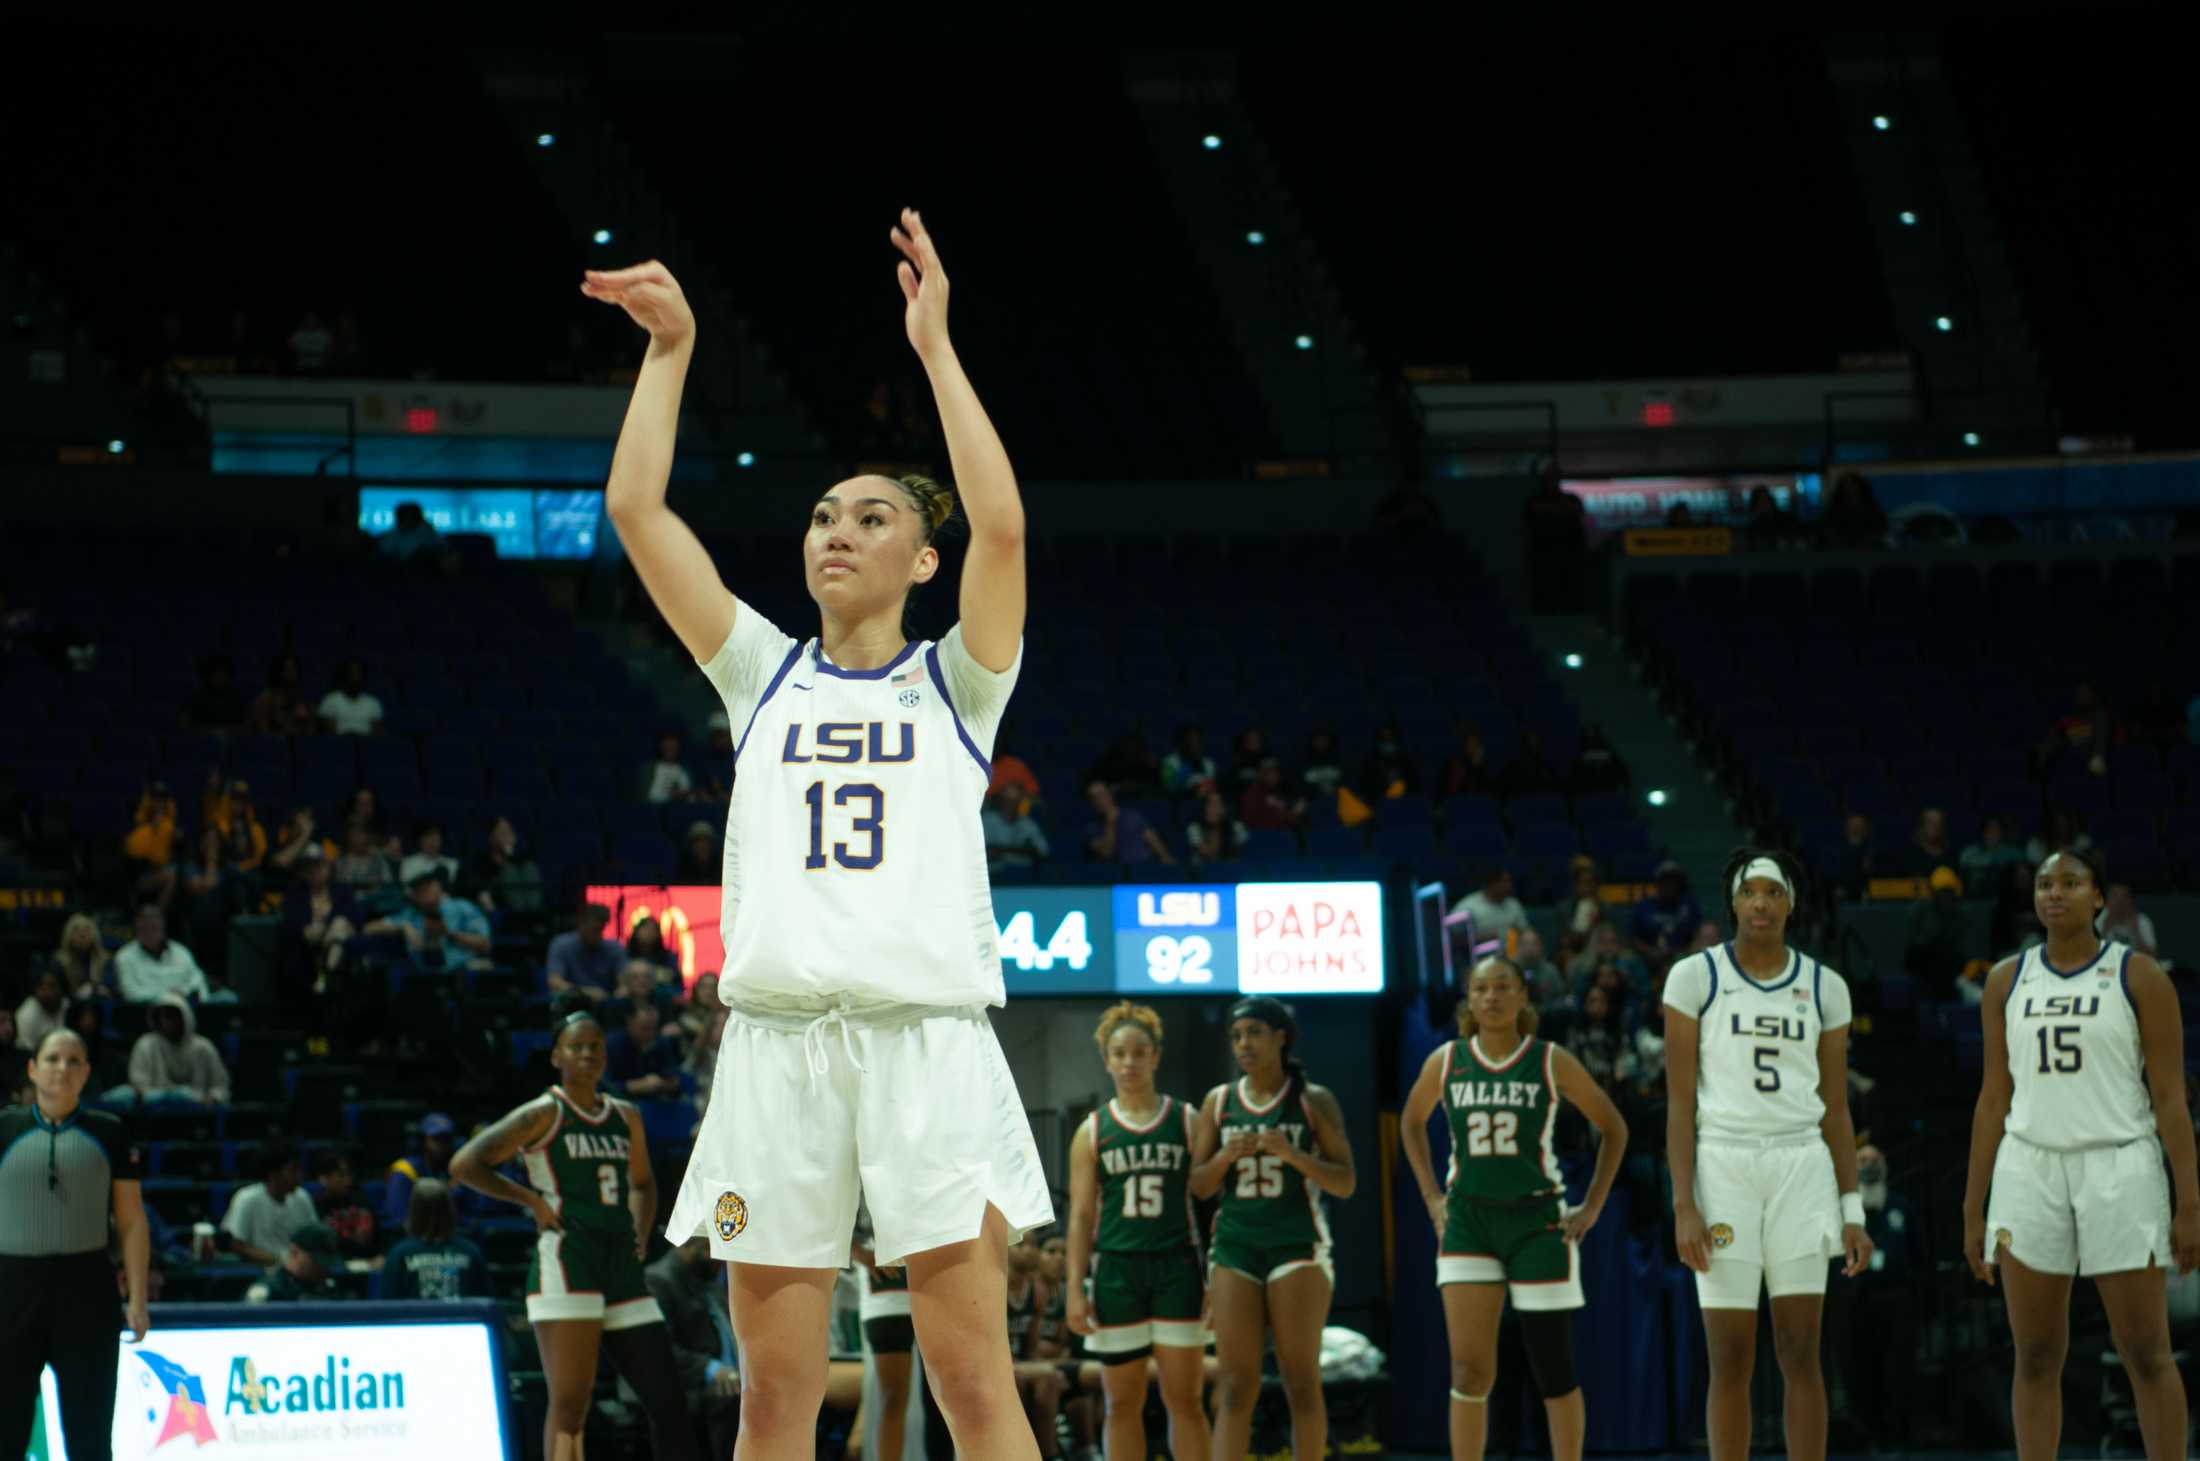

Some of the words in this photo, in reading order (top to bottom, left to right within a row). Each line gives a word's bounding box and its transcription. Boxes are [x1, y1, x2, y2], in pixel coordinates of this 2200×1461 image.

[782, 721, 915, 764] LSU
[805, 781, 884, 870] 13
[1136, 892, 1220, 926] LSU
[1253, 902, 1363, 939] PAPA
[992, 911, 1092, 970] 4.4
[1145, 934, 1213, 984] 92
[1252, 949, 1367, 975] JOHNS
[1731, 1013, 1805, 1041] LSU
[2024, 996, 2099, 1018] LSU
[1754, 1047, 1780, 1092] 5
[2036, 1026, 2082, 1074] 15
[1450, 1081, 1541, 1109] VALLEY
[563, 1133, 630, 1160] VALLE
[1467, 1111, 1519, 1157] 22
[1100, 1142, 1184, 1175] VALLEY
[1235, 1156, 1283, 1198] 25
[596, 1163, 619, 1206] 2
[1122, 1174, 1164, 1218] 15
[225, 1355, 405, 1415] Acadian
